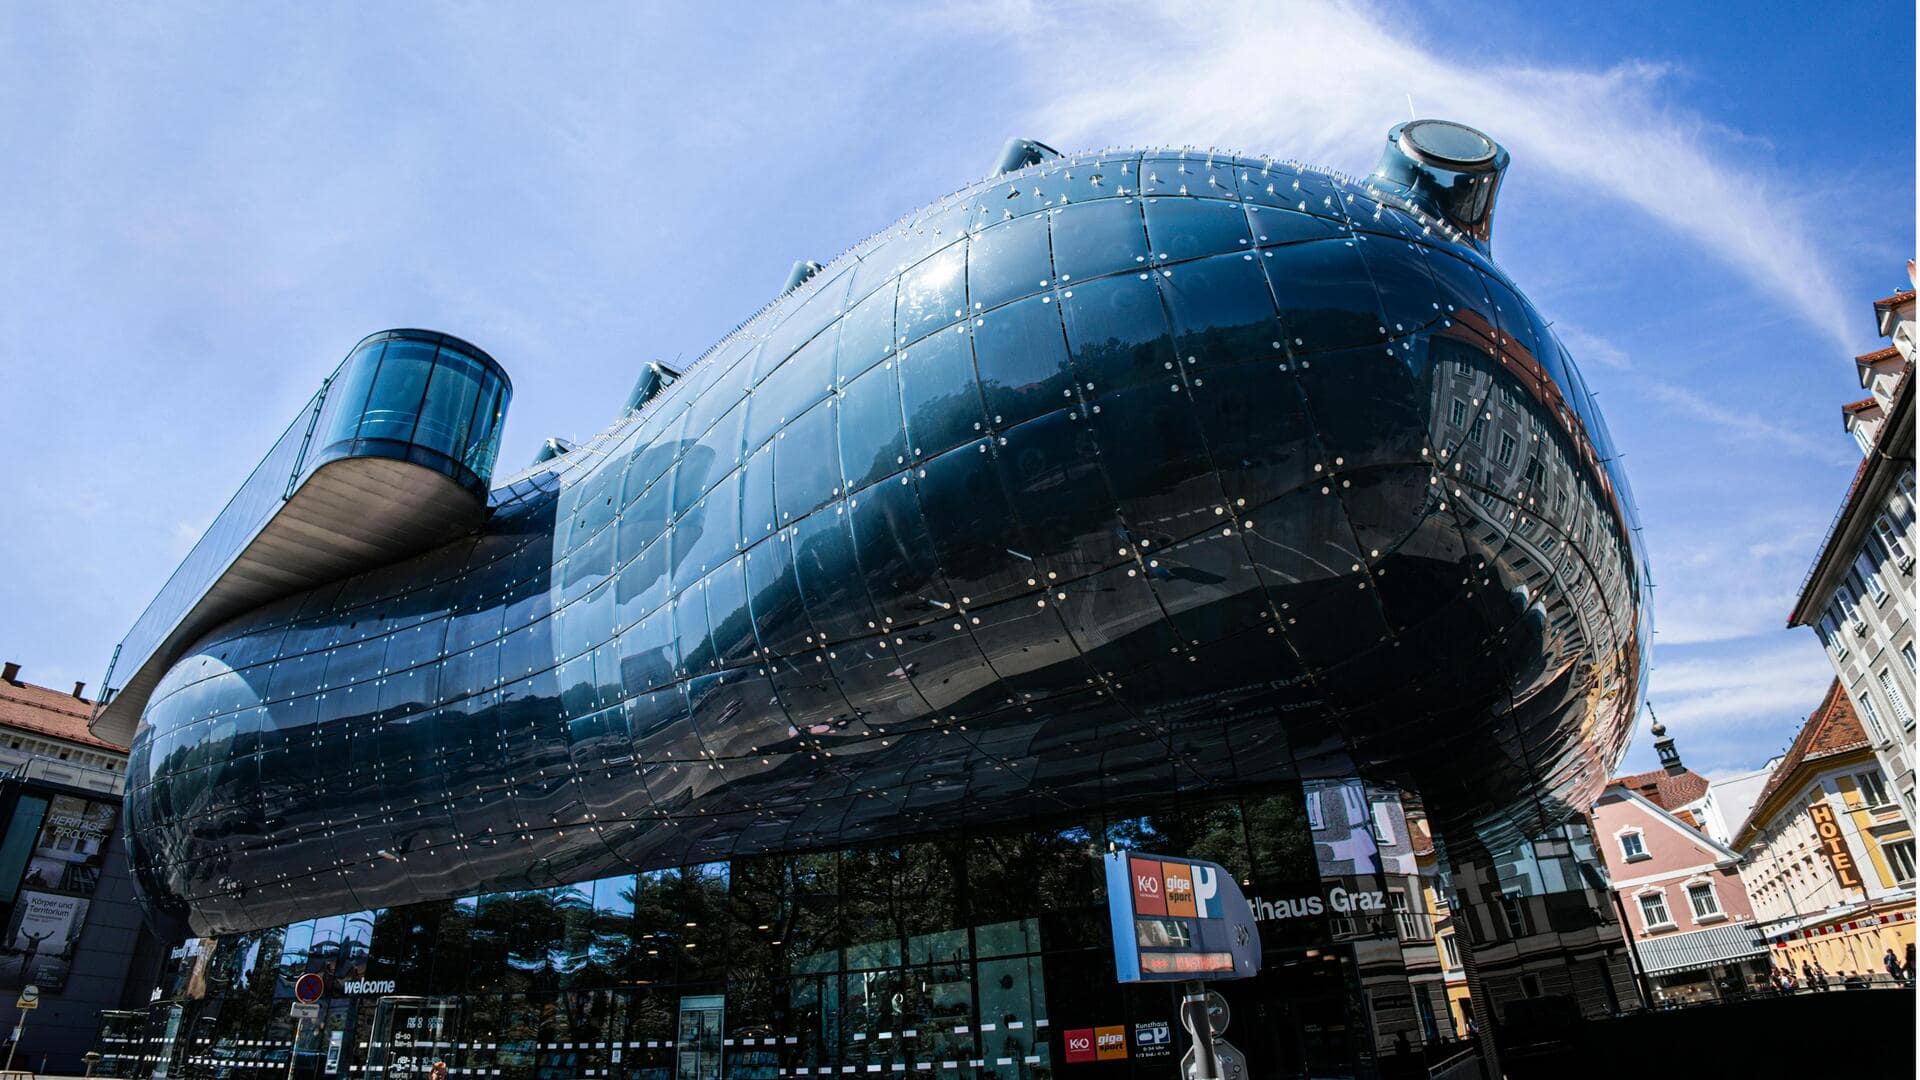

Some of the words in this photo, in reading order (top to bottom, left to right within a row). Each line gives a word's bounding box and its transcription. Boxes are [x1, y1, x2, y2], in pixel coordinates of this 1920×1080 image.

[47, 814, 106, 832] HERITAGE
[53, 827, 109, 843] PROJECT
[1811, 805, 1857, 886] HOTEL
[1166, 874, 1191, 892] giga
[1168, 890, 1192, 904] sport
[1191, 865, 1217, 918] P
[31, 896, 57, 908] Körper
[1246, 894, 1324, 921] thaus
[1330, 887, 1386, 912] Graz
[30, 905, 69, 917] Territorium
[344, 977, 395, 994] welcome
[1135, 1021, 1168, 1029] Kunsthaus
[1098, 1033, 1123, 1045] giga
[1099, 1042, 1123, 1052] sport
